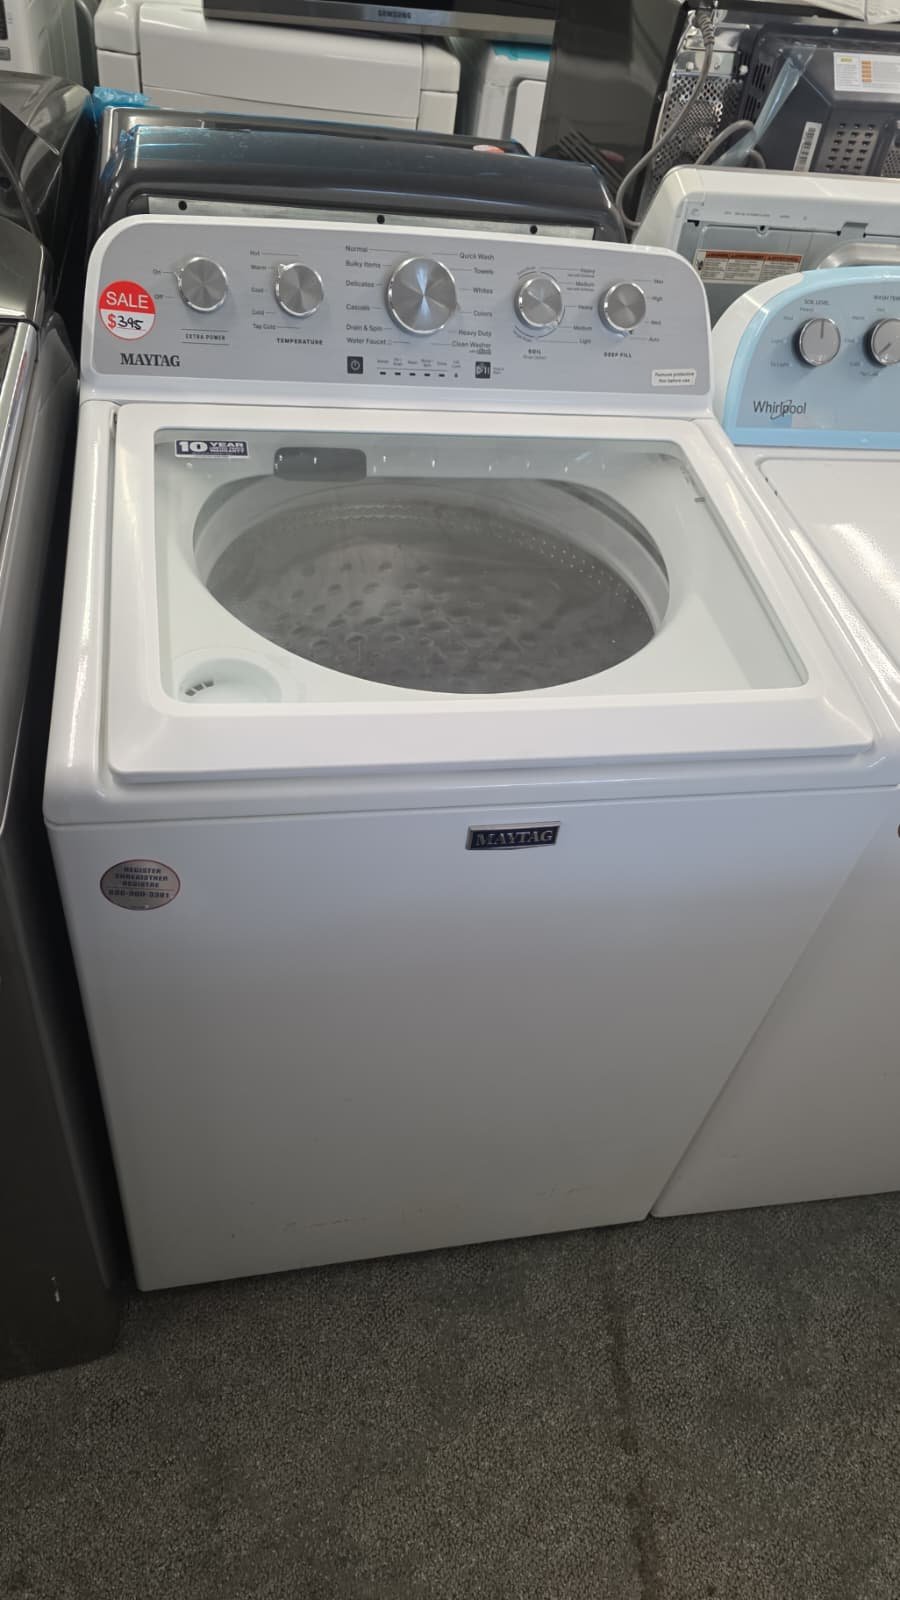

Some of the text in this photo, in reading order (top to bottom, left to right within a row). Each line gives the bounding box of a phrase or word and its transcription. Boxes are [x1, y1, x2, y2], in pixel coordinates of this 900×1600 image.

[345, 245, 368, 253] Normal
[459, 252, 477, 260] Quick
[345, 260, 381, 269] Bulky Items
[473, 287, 493, 295] Whites
[106, 291, 149, 309] SALE
[346, 323, 362, 331] Drain
[369, 324, 383, 333] Spin
[459, 329, 492, 338] Heavy Duty
[276, 337, 323, 345] TEMPERATURE
[346, 337, 362, 345] Water
[470, 341, 492, 349] Washer
[120, 352, 181, 368] MAYTAG
[753, 400, 807, 420] Whirlpool
[178, 441, 208, 452] 10
[476, 830, 553, 846] MAYTAG
